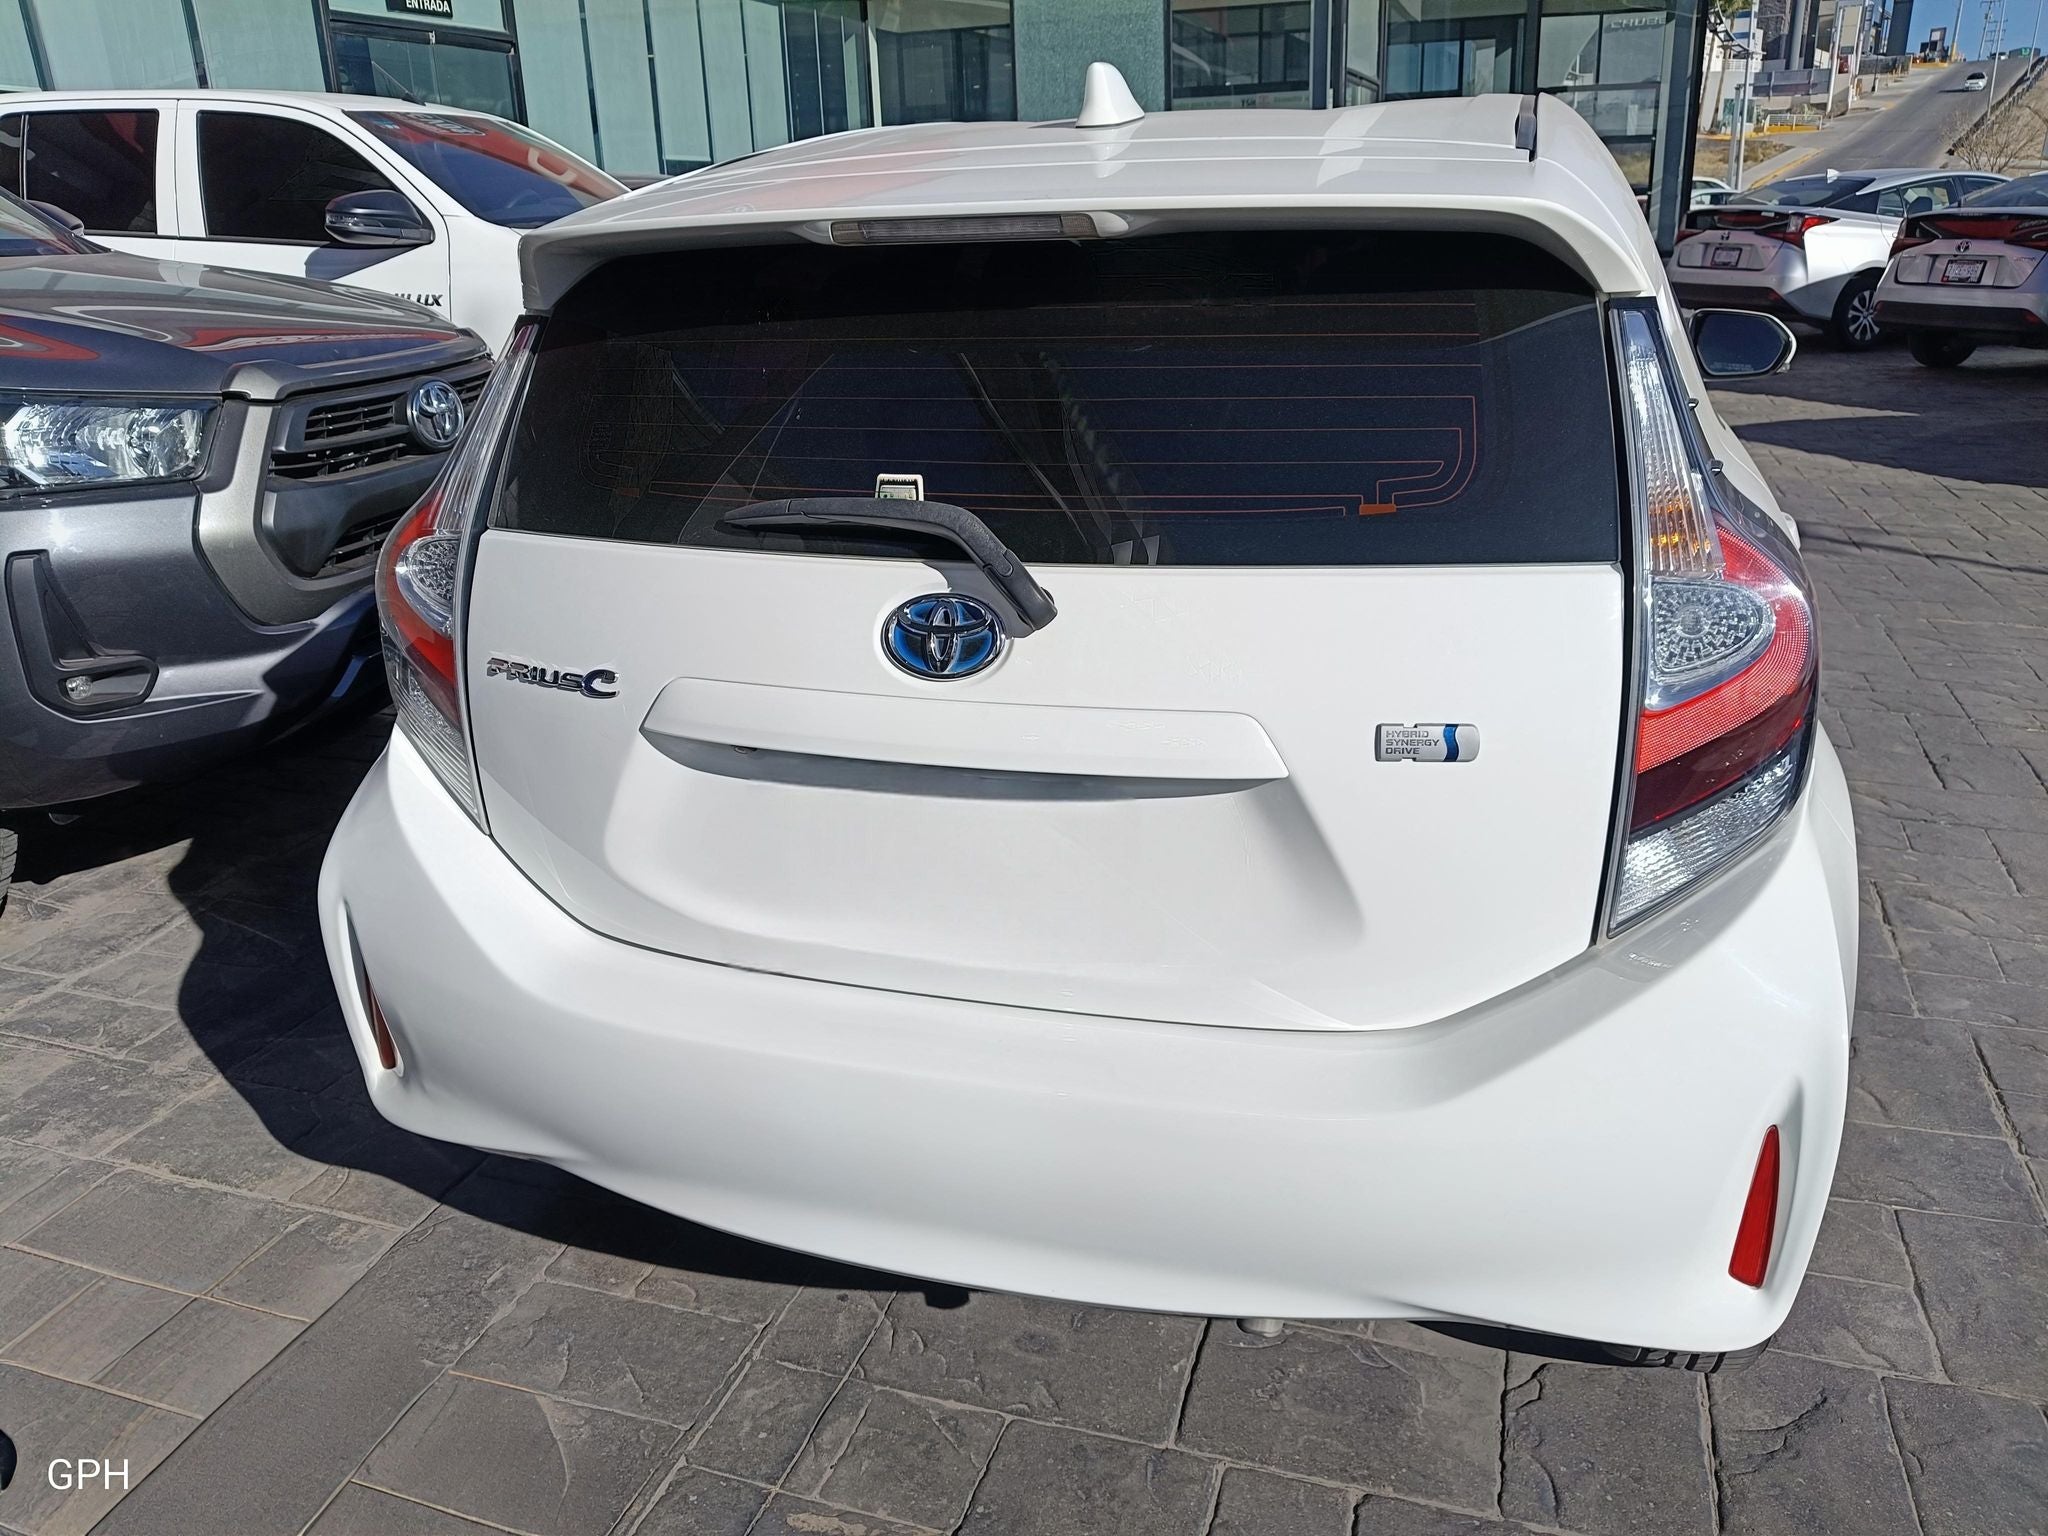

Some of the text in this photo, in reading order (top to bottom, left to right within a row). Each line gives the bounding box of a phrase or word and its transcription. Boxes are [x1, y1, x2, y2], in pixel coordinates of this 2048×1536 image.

[405, 0, 451, 13] ENTRADA
[1385, 730, 1429, 738] HYBRID
[1385, 739, 1440, 747] SYNERGY
[1385, 747, 1420, 755] DRIVE
